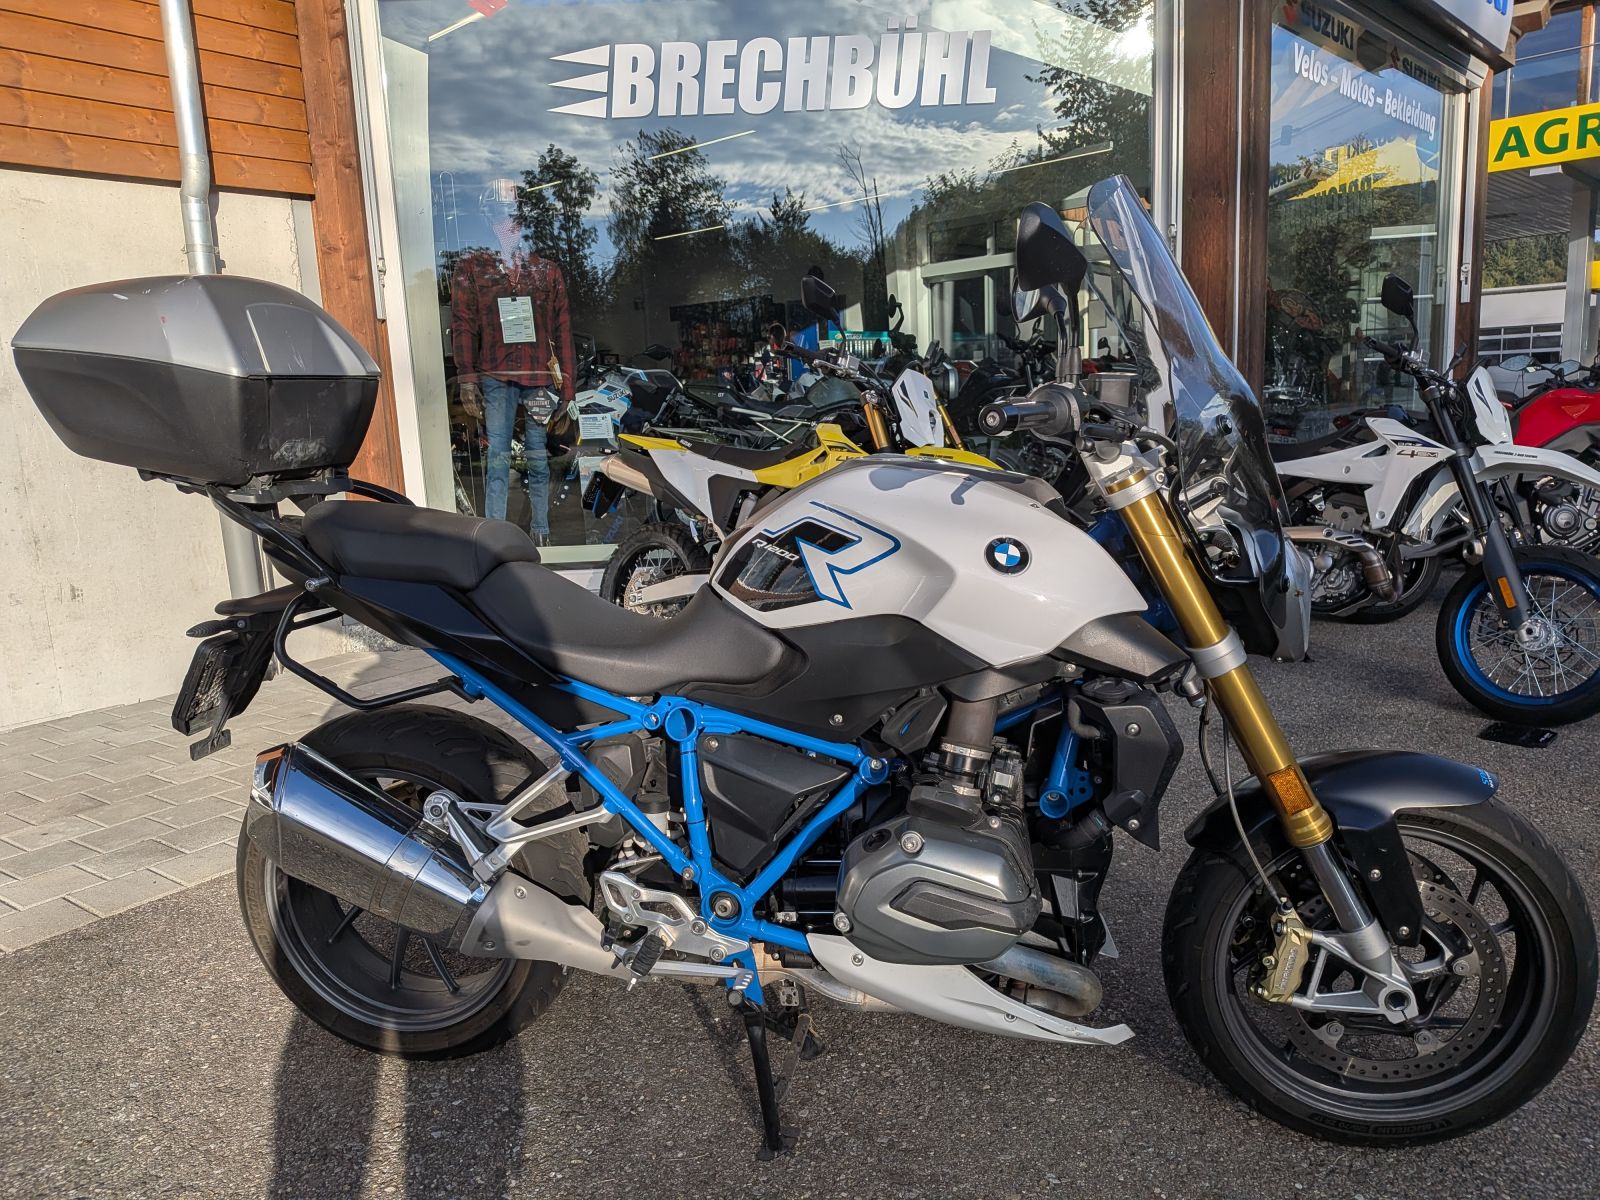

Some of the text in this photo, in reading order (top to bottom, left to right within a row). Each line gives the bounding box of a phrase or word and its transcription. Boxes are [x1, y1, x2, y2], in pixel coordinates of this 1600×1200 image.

[611, 17, 997, 118] BRECHBÜHL
[1293, 42, 1328, 87] Velos
[1340, 68, 1375, 108] Motos
[1384, 87, 1436, 141] Bekleidung
[752, 538, 800, 561] R1200
